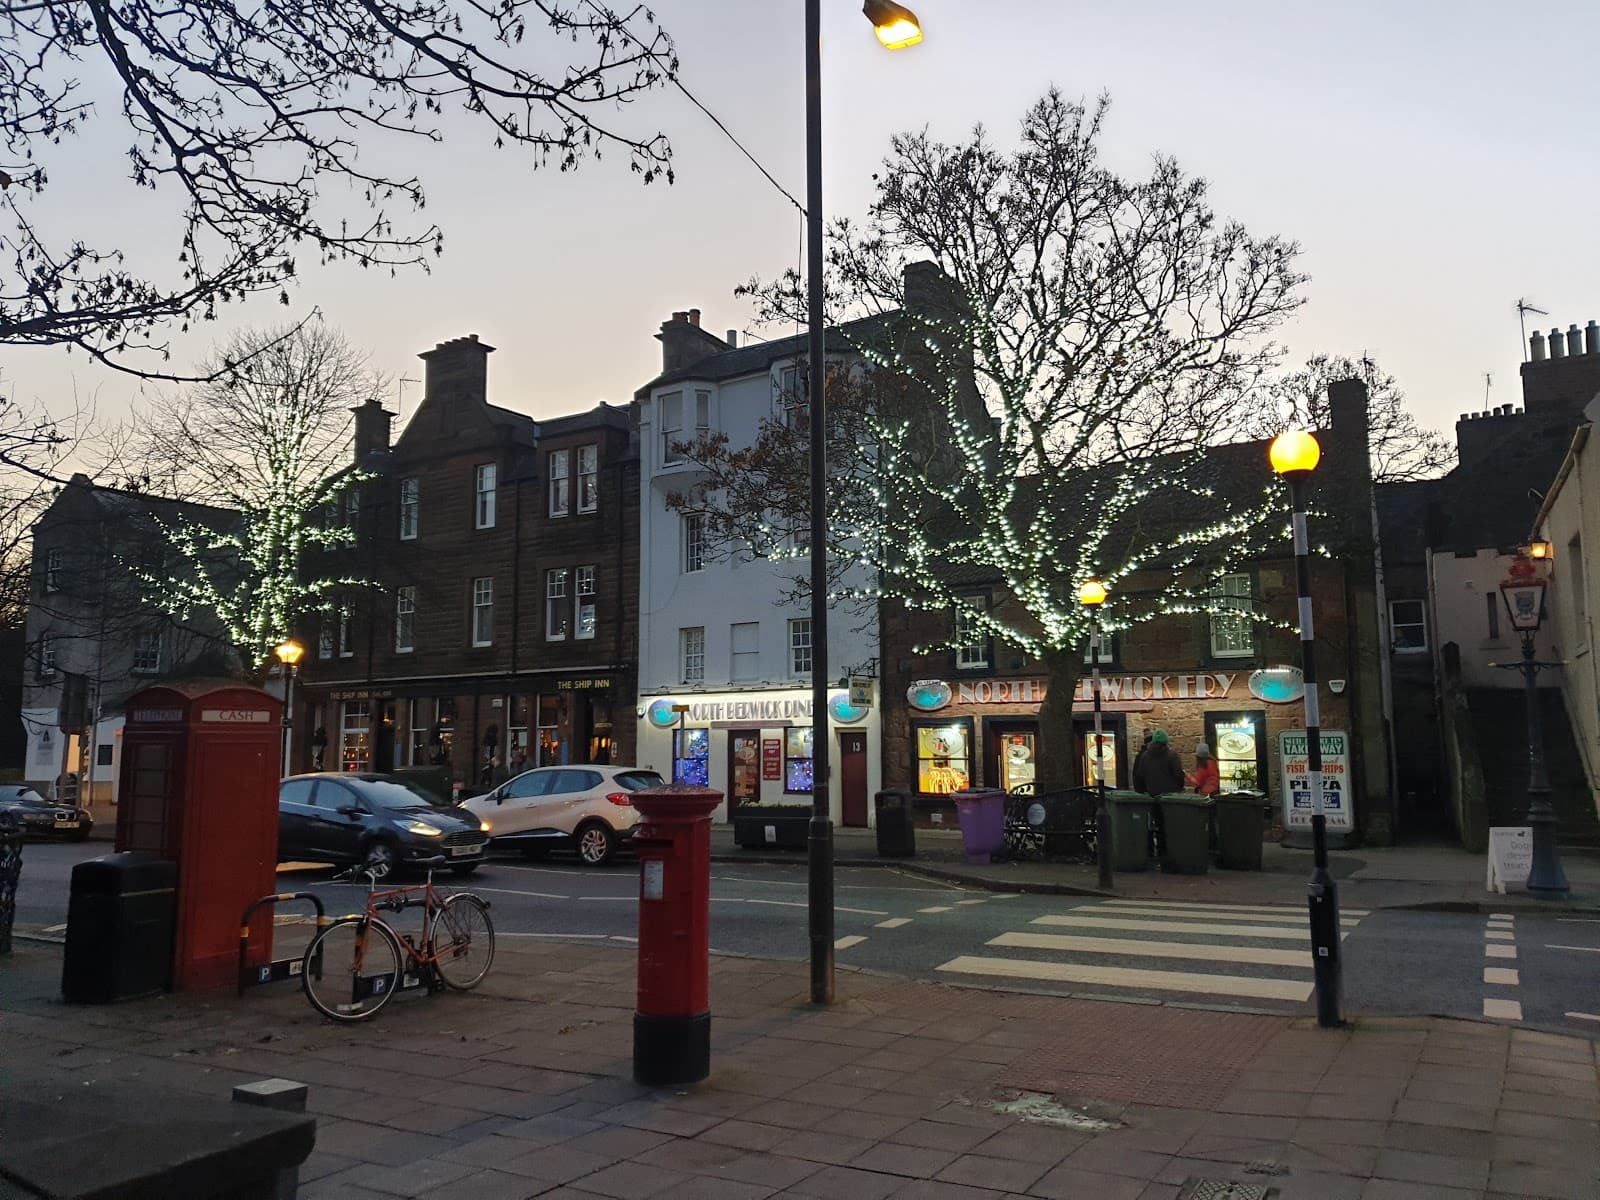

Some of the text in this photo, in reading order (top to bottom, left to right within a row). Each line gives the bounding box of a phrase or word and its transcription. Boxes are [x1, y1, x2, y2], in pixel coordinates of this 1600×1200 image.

[558, 679, 610, 689] THE SHIP INN
[958, 679, 1042, 704] NORTH
[1178, 674, 1237, 698] FRY
[727, 699, 782, 719] BERWICK
[219, 711, 254, 721] CASH
[852, 741, 861, 753] 13
[1286, 764, 1305, 774] FISH
[261, 967, 270, 980] P
[376, 978, 384, 991] P
